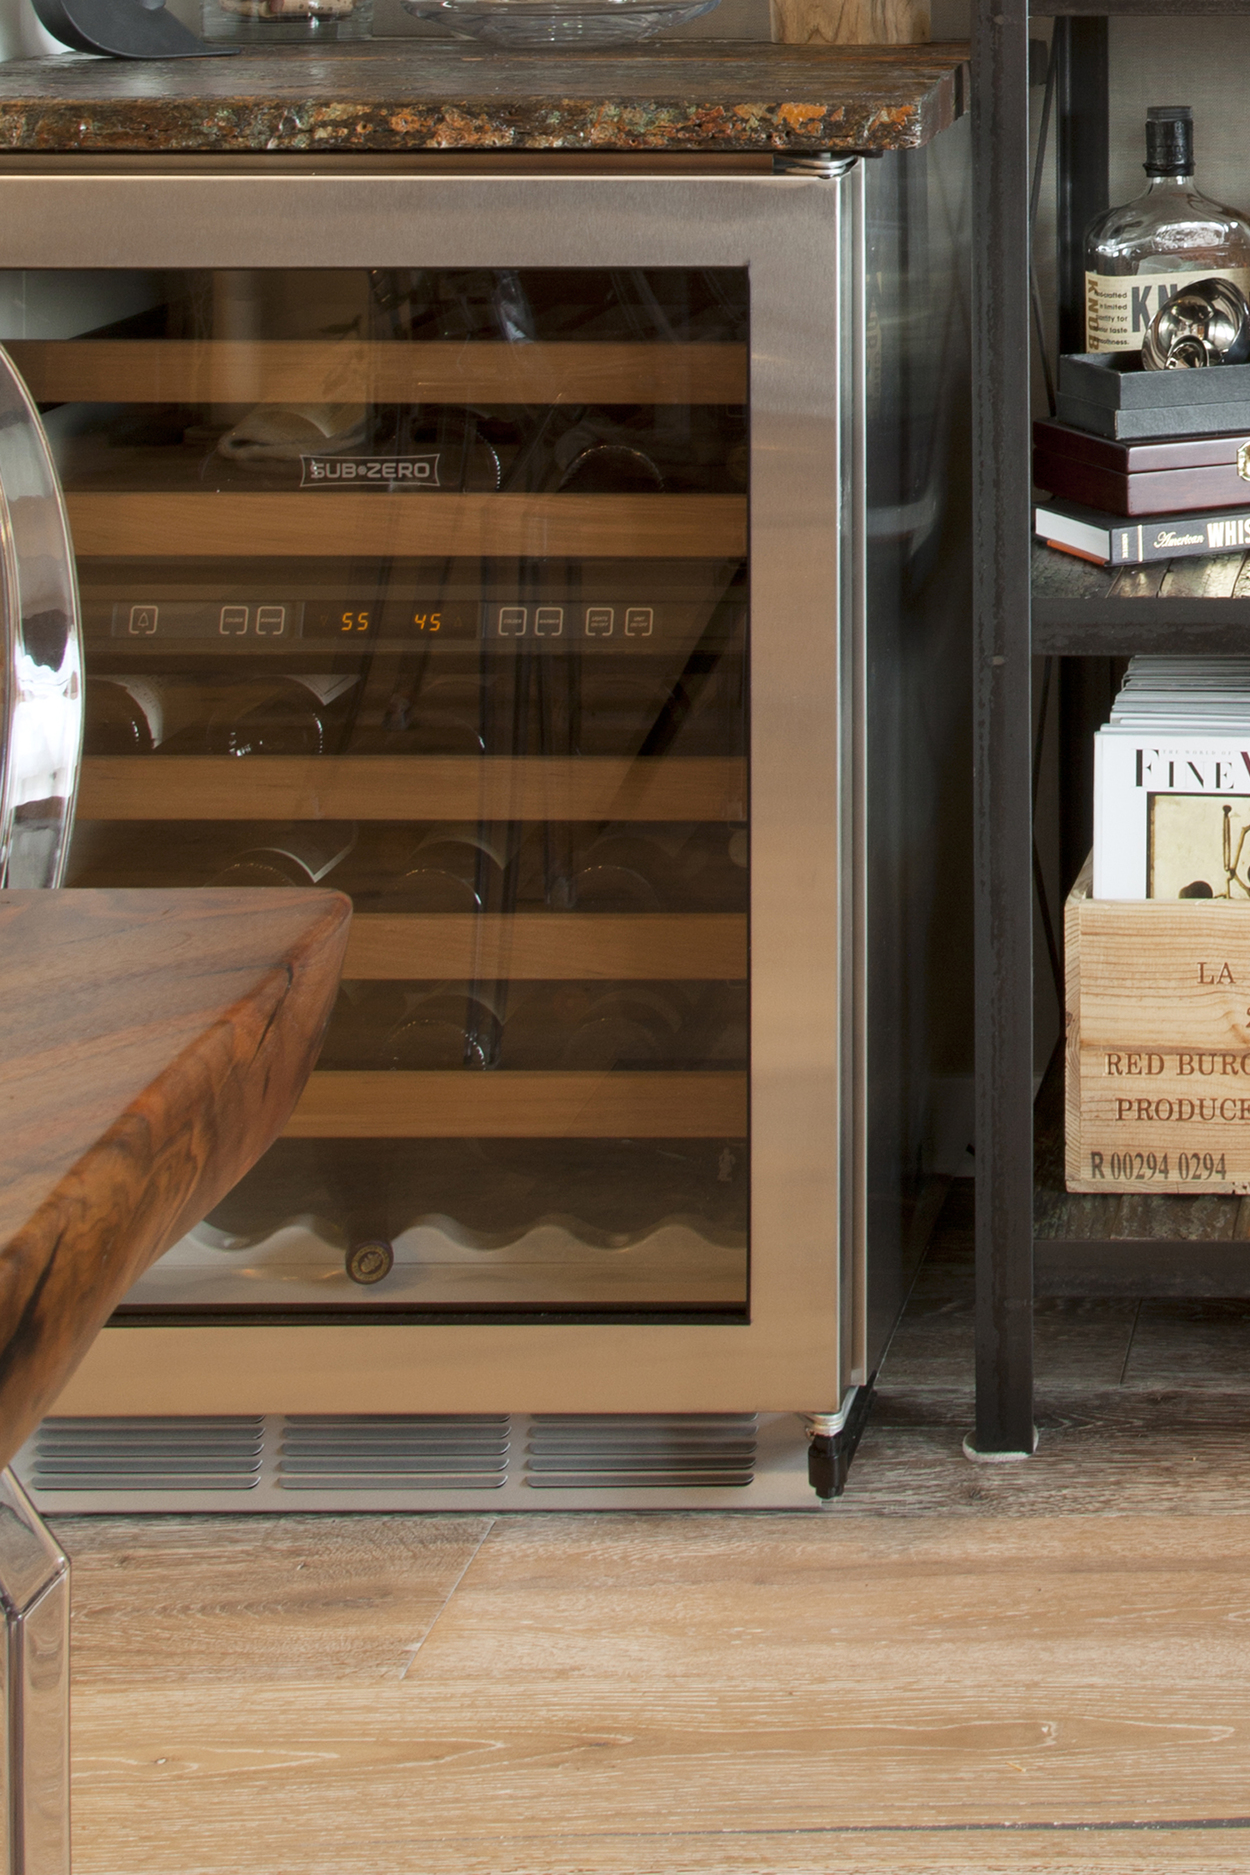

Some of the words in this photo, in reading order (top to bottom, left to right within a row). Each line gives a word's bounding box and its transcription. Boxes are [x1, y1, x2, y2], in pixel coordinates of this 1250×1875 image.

[1109, 326, 1128, 334] taste
[1153, 531, 1205, 549] American
[342, 611, 369, 632] 55
[1197, 961, 1236, 986] LA
[1105, 1052, 1165, 1077] RED
[1110, 1152, 1170, 1181] 00294
[1177, 1152, 1227, 1181] 0294
